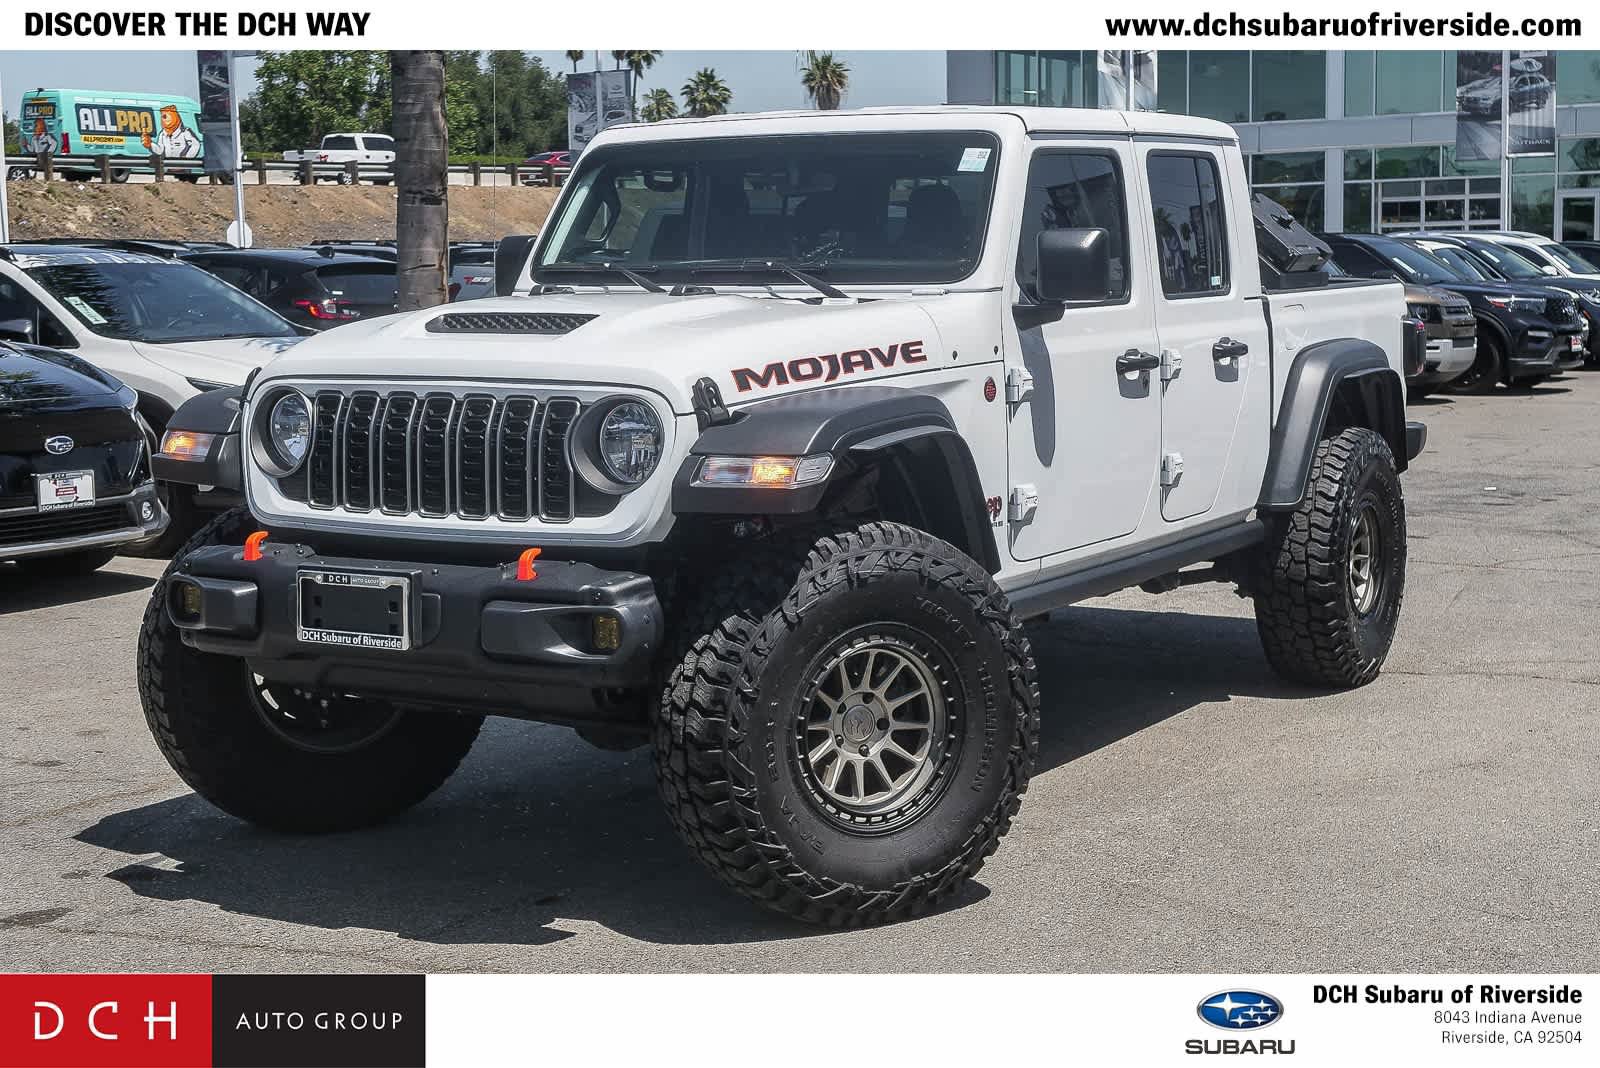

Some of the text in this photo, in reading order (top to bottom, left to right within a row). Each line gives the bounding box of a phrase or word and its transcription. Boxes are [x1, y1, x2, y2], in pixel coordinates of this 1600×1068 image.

[78, 107, 154, 133] ALLPRO
[731, 340, 927, 393] MOJAVE
[328, 575, 348, 583] DCH
[302, 630, 402, 649] DCH Subaru of Riverside
